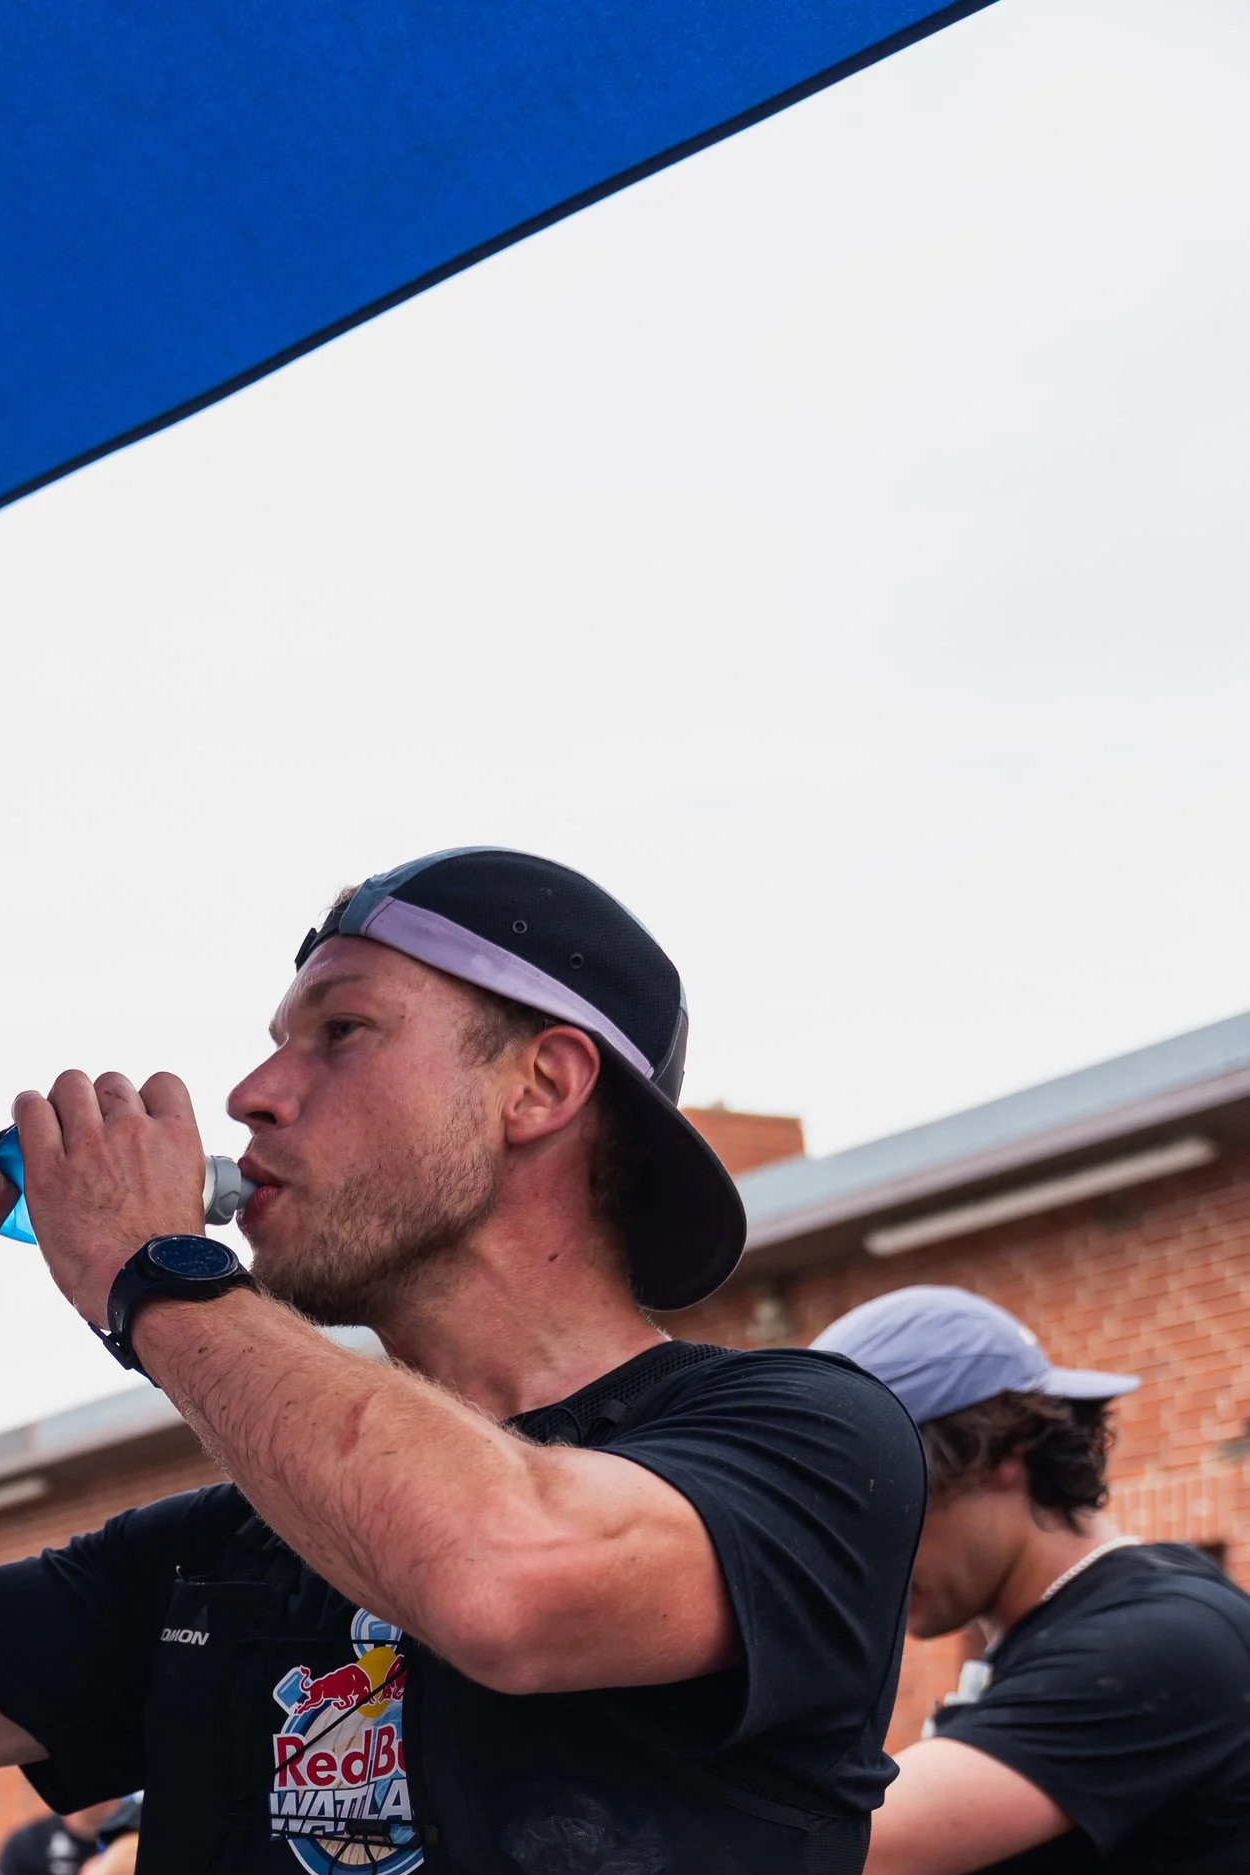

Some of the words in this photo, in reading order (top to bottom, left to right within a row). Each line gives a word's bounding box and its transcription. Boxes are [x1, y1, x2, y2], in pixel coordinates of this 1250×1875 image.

[161, 1628, 209, 1645] OMON
[277, 1729, 372, 1788] Red
[269, 1779, 413, 1836] WATTLA
